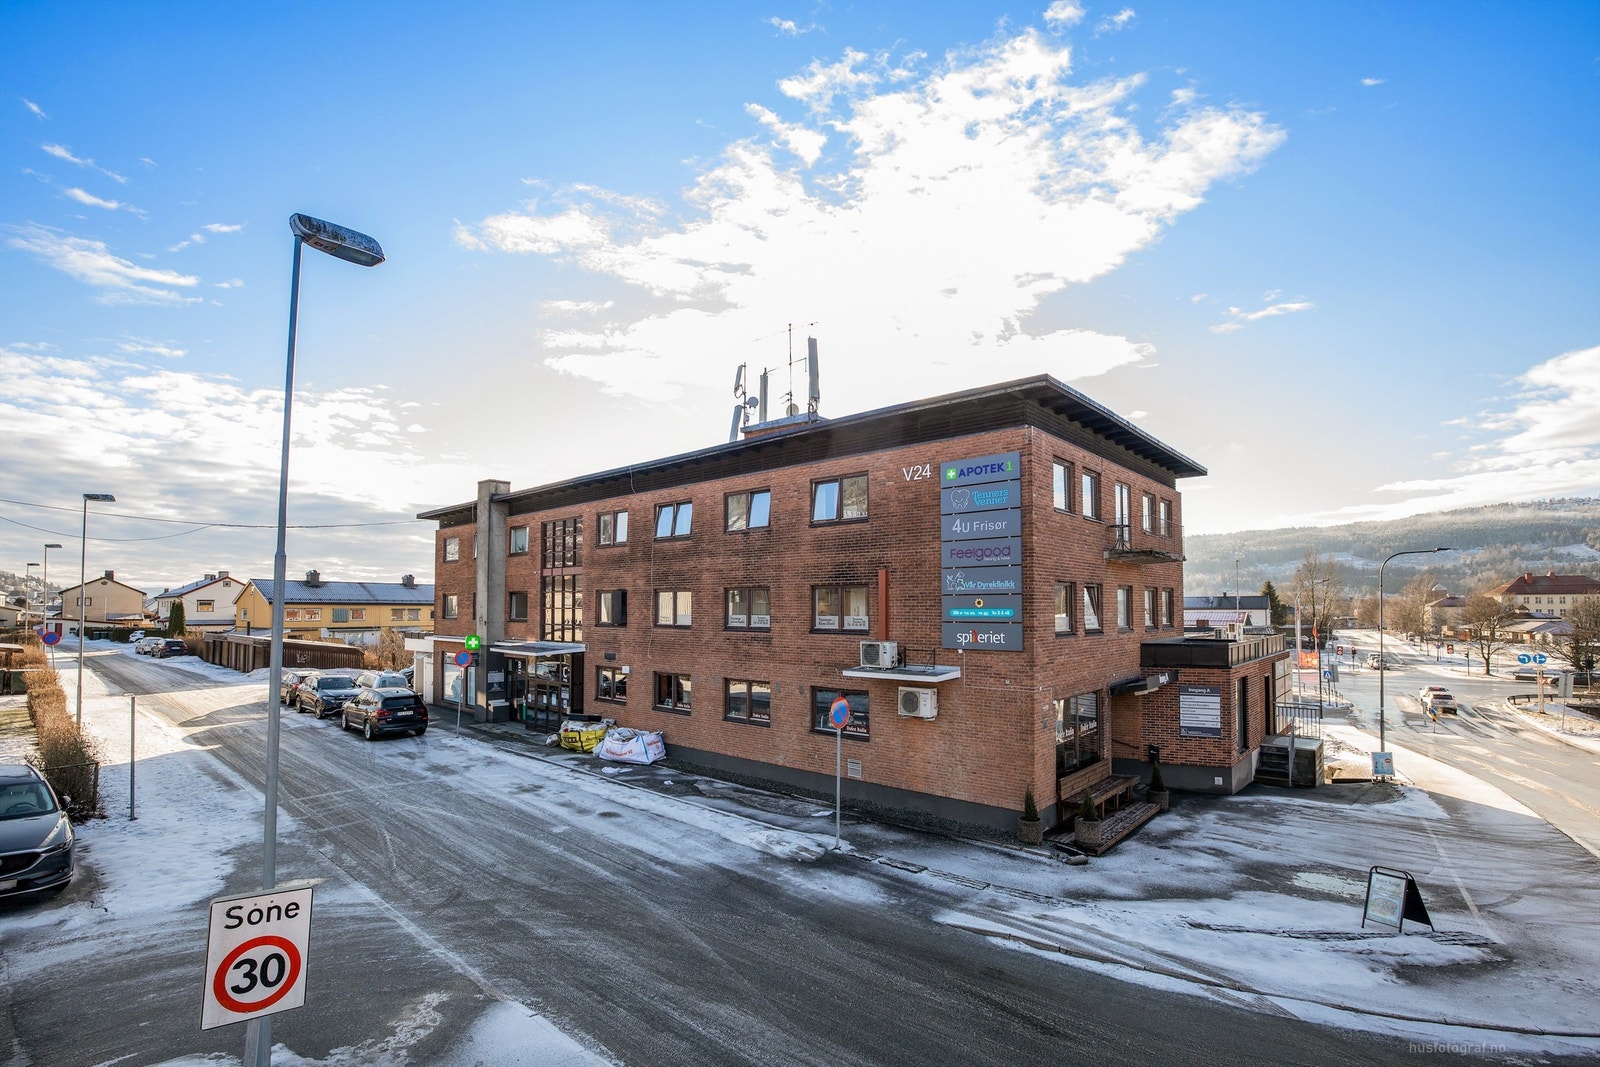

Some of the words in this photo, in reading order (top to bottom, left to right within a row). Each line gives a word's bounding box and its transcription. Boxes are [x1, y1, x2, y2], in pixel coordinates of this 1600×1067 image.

[902, 464, 931, 481] V24
[958, 462, 1005, 478] APOTEK
[1006, 461, 1013, 471] 1
[972, 489, 1009, 499] Tenners
[973, 521, 1008, 532] Frisør
[950, 545, 1011, 561] Feelgood
[224, 901, 300, 930] Sone
[230, 952, 286, 995] 30
